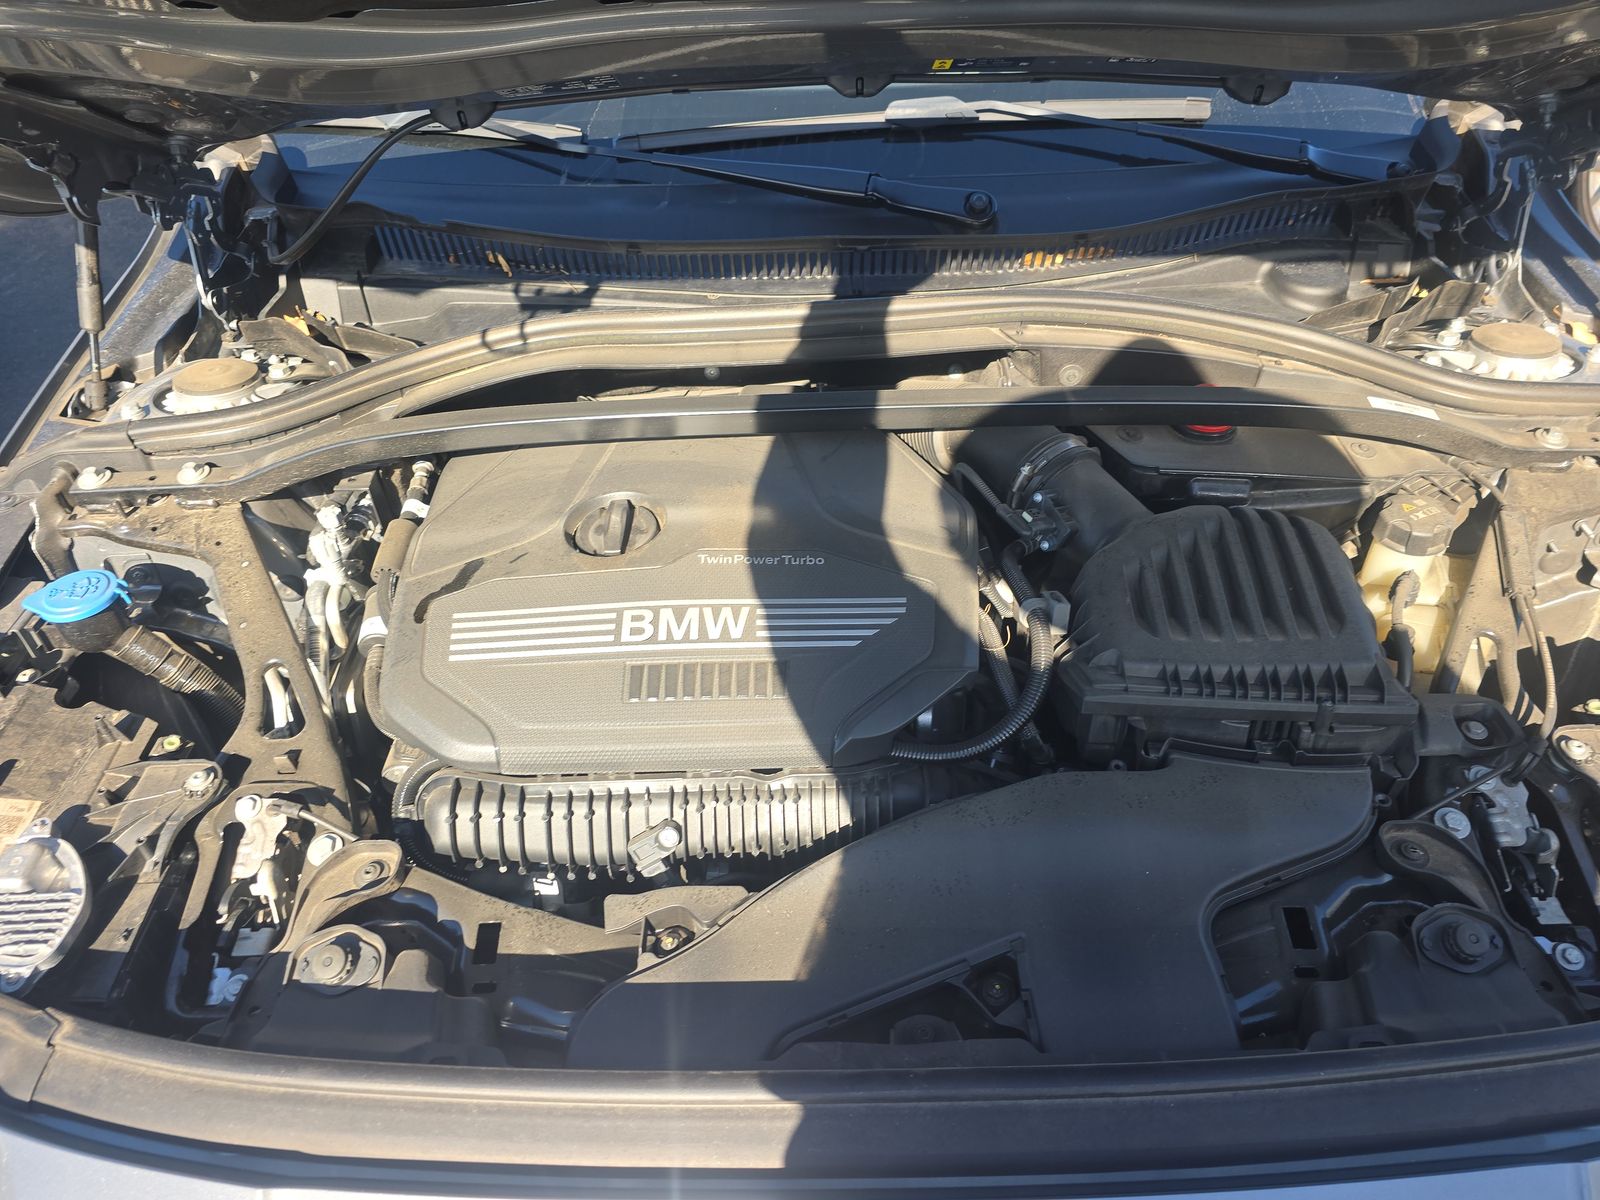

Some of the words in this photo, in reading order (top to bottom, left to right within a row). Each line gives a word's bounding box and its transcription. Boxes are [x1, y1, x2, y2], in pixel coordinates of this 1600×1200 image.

[698, 554, 780, 565] TwinPower
[782, 555, 825, 565] Turbo
[620, 607, 750, 643] BMW
